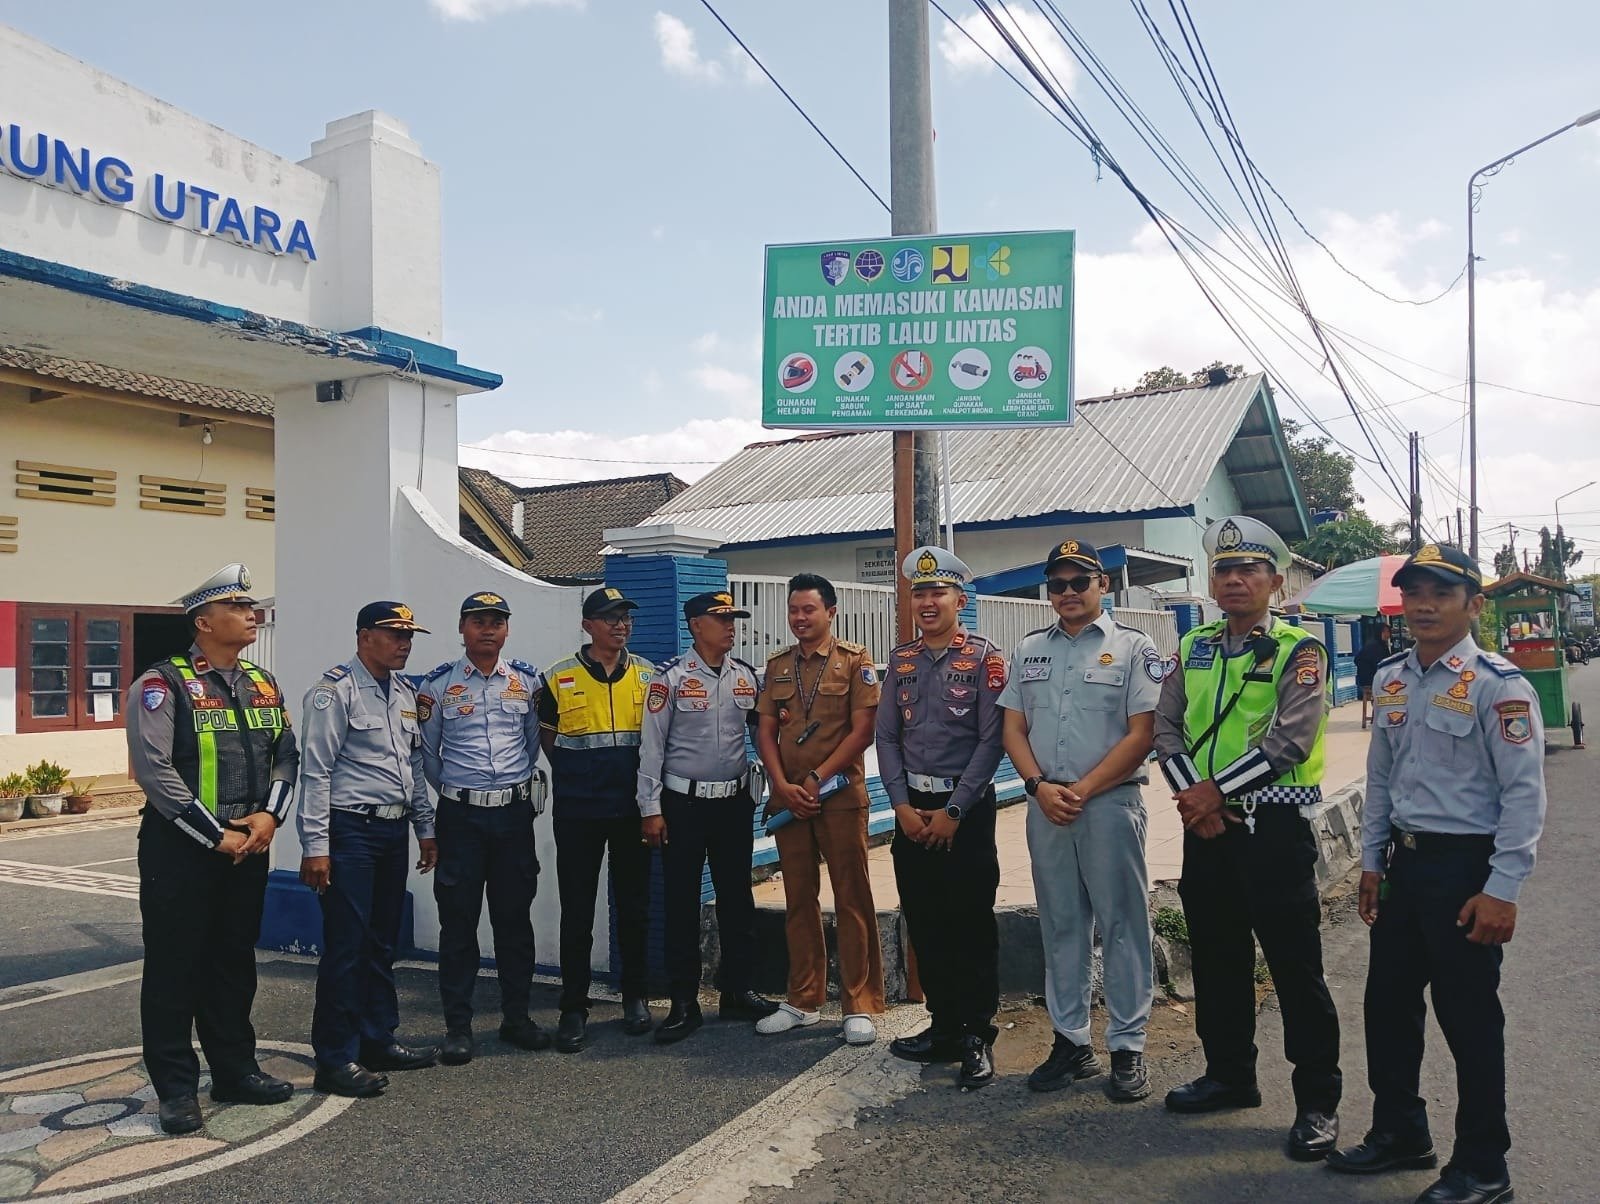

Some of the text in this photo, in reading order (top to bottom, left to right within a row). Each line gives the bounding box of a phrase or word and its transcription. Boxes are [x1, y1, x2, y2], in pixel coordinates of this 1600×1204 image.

[0, 124, 317, 262] UNG UTARA
[773, 285, 1063, 319] ANDA MEMASUKI KAWASAN
[813, 318, 1017, 347] TERTIB LALU LINTAS
[777, 398, 817, 407] GUNAKAN
[835, 395, 870, 403] GUNAKAN
[885, 394, 913, 402] JANGAN
[905, 401, 925, 409] SAAT
[777, 407, 816, 415] HELM SNI
[831, 409, 872, 417] PENGAMAN
[1023, 656, 1052, 665] FIKRI
[946, 673, 977, 686] POLRI
